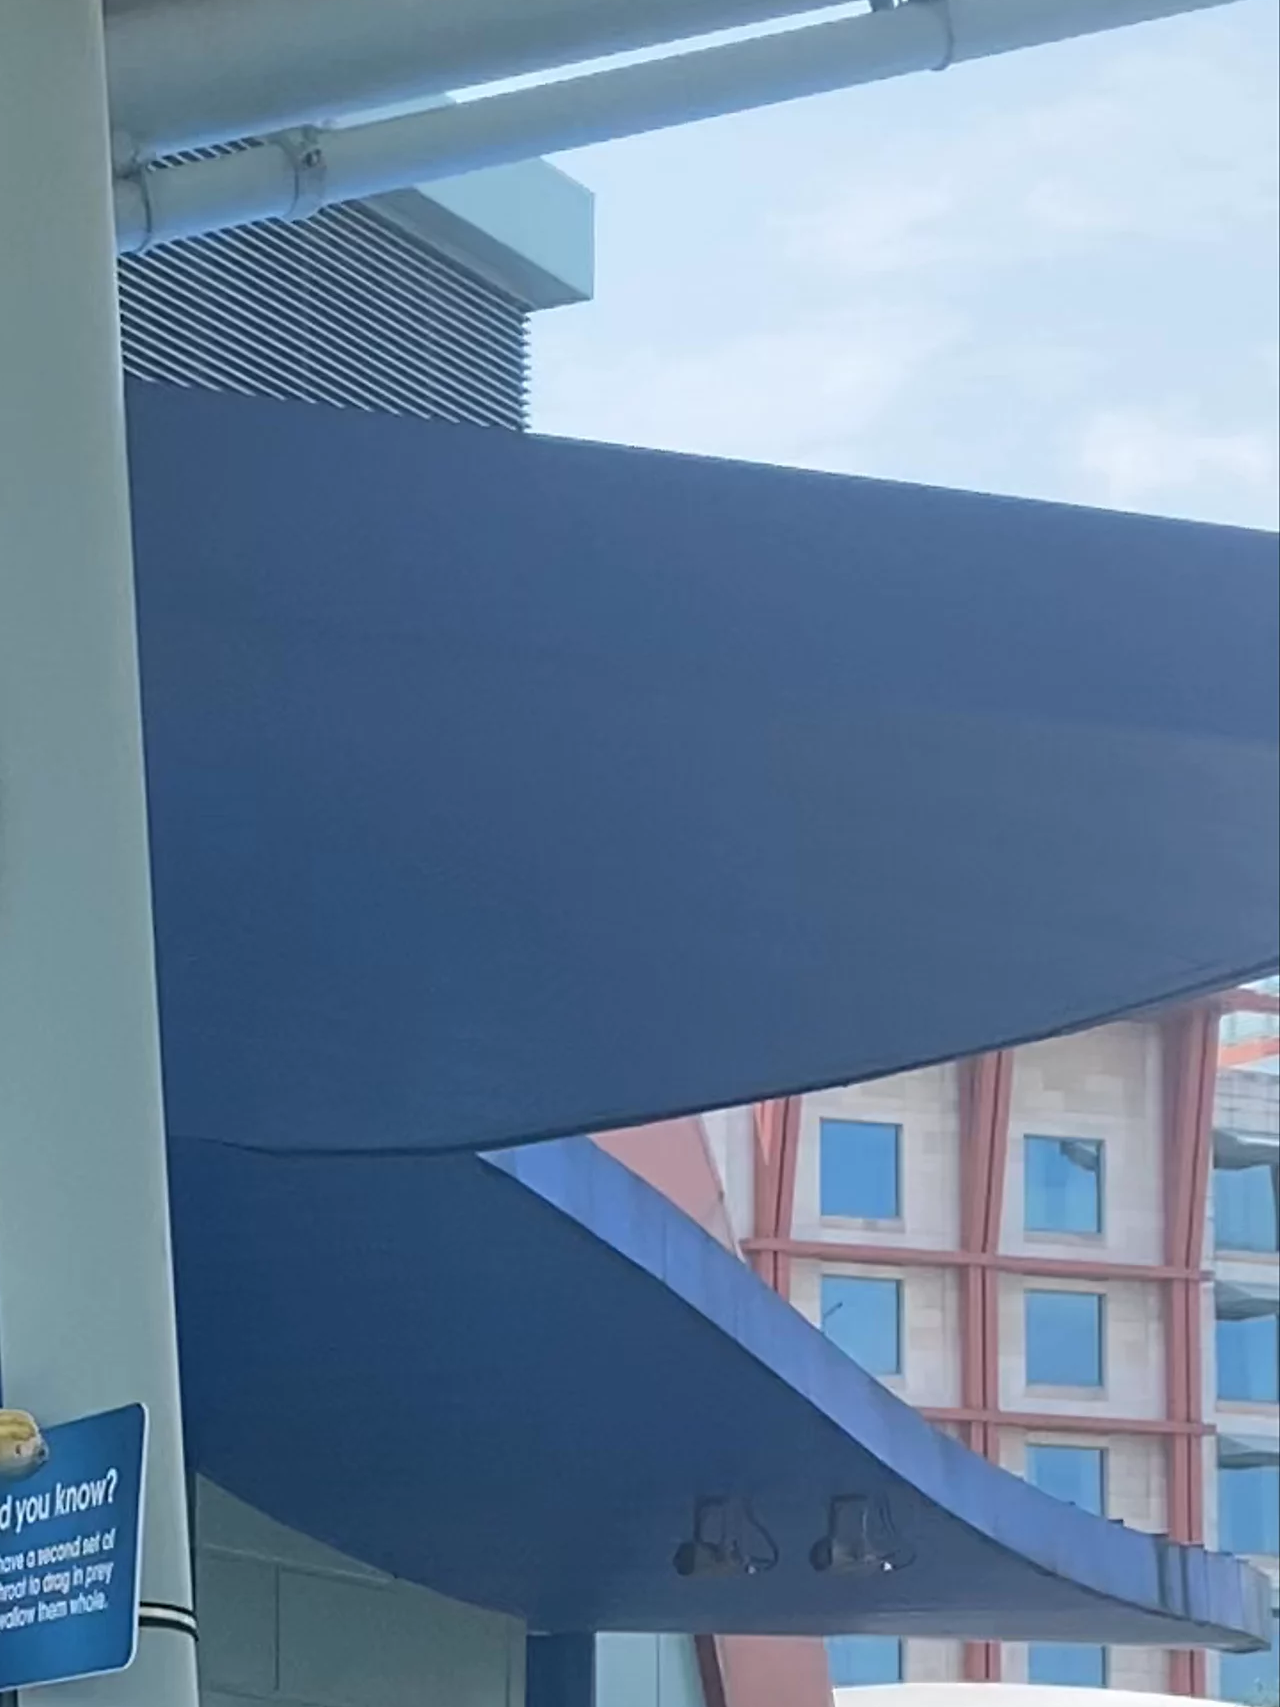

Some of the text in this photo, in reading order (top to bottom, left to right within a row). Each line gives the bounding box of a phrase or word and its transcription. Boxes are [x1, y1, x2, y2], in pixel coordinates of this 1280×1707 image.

[16, 1493, 49, 1534] you
[54, 1468, 118, 1516] know?
[26, 1552, 35, 1568] a
[38, 1535, 81, 1566] second
[83, 1533, 100, 1555] set
[102, 1528, 116, 1551] of
[29, 1576, 40, 1594] to
[42, 1570, 69, 1594] drag
[72, 1565, 83, 1586] in
[84, 1562, 114, 1588] prey
[38, 1599, 68, 1622] them
[70, 1590, 109, 1614] whole.
